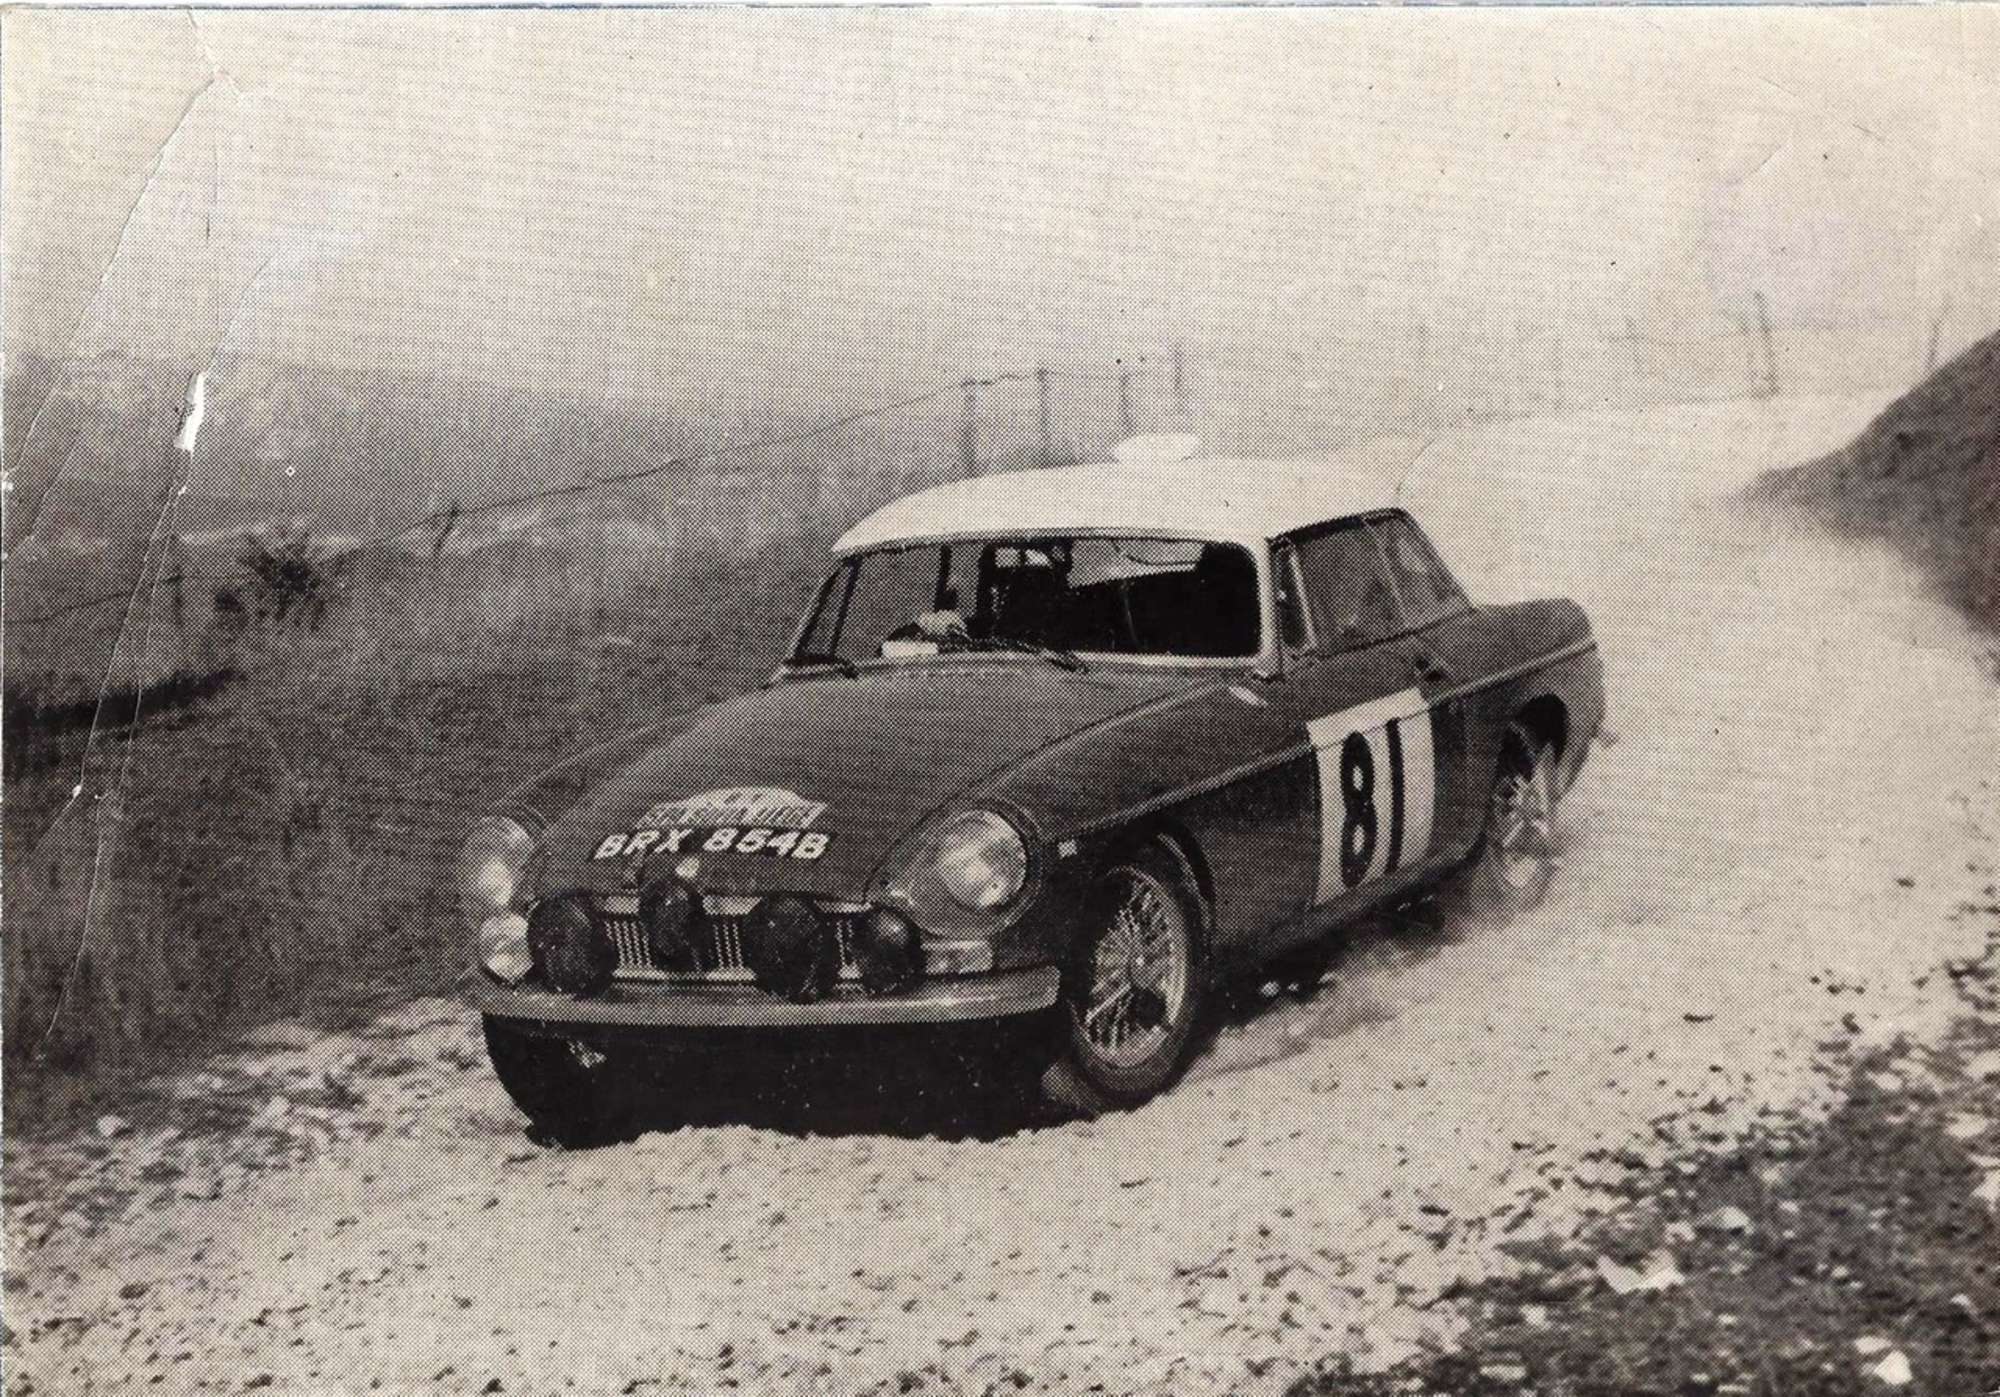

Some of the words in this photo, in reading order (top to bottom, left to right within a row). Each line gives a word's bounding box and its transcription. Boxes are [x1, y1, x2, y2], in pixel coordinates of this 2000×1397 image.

[594, 828, 692, 859] BRX
[703, 828, 830, 859] 854B
[1340, 716, 1405, 888] 81
